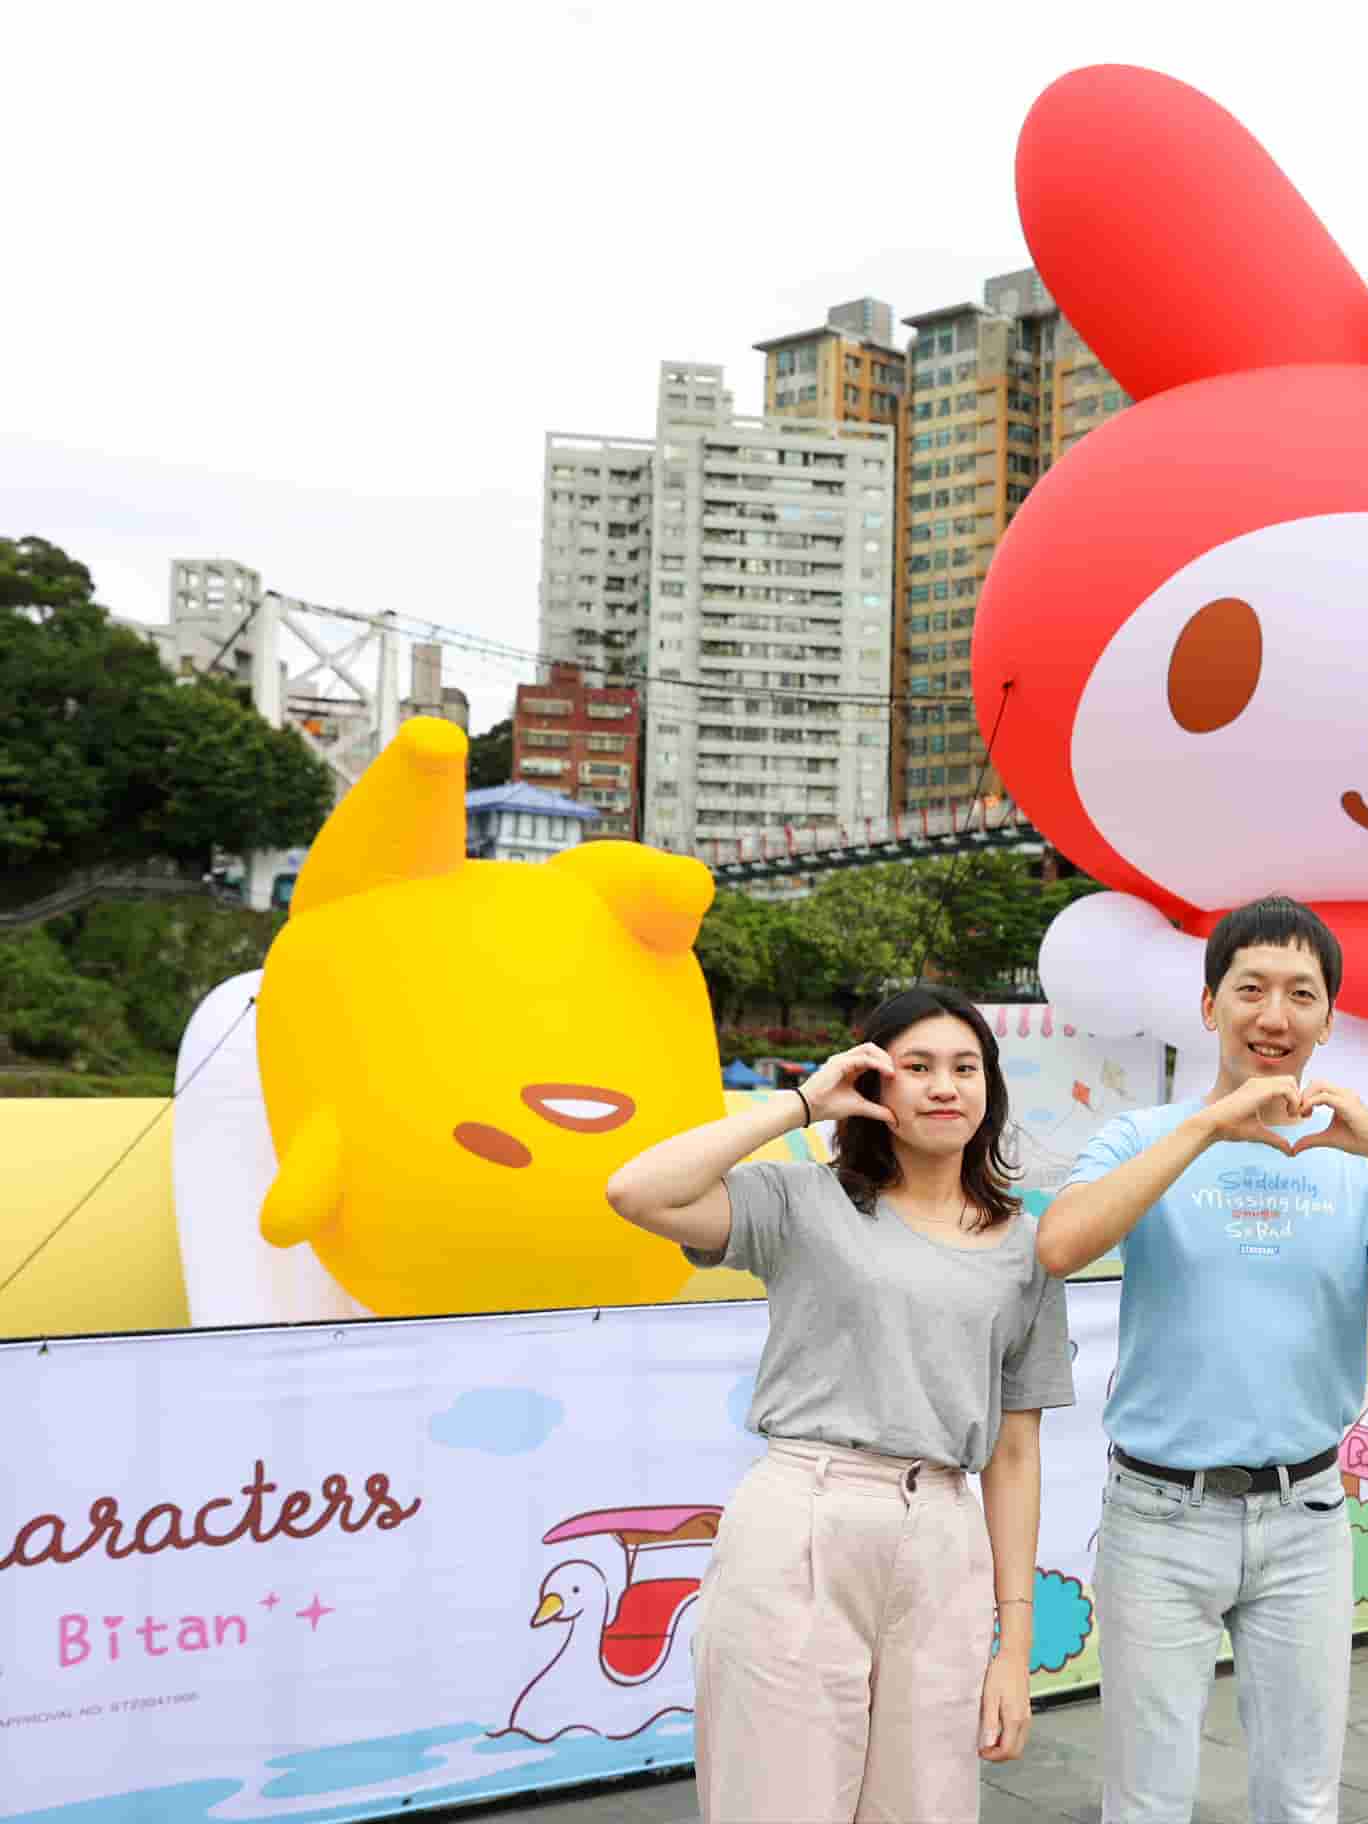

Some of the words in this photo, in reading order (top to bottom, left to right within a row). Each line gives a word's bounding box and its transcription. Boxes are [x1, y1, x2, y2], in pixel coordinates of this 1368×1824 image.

[1216, 1170, 1320, 1198] Suddenly
[1191, 1187, 1289, 1214] Missing
[59, 1613, 247, 1667] Bitan
